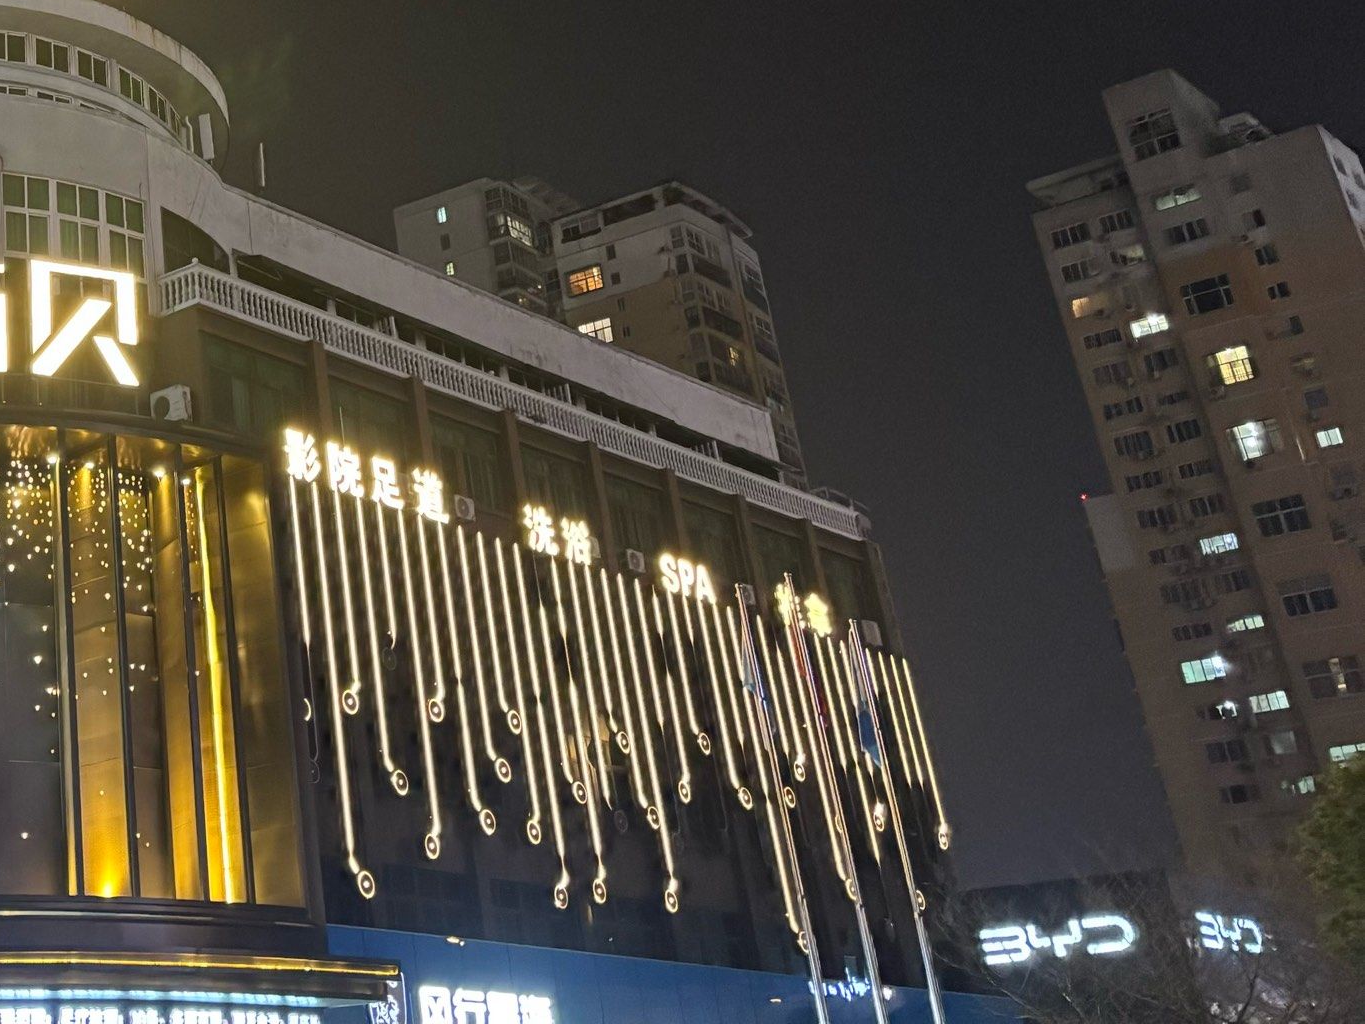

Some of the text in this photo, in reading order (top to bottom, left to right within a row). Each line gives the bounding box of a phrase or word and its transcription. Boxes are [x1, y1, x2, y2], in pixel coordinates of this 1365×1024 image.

[283, 428, 450, 523] 影院足道
[523, 503, 591, 565] 洗浴
[659, 552, 717, 604] SPA
[979, 914, 1137, 966] BYD
[1196, 911, 1263, 954] BYD
